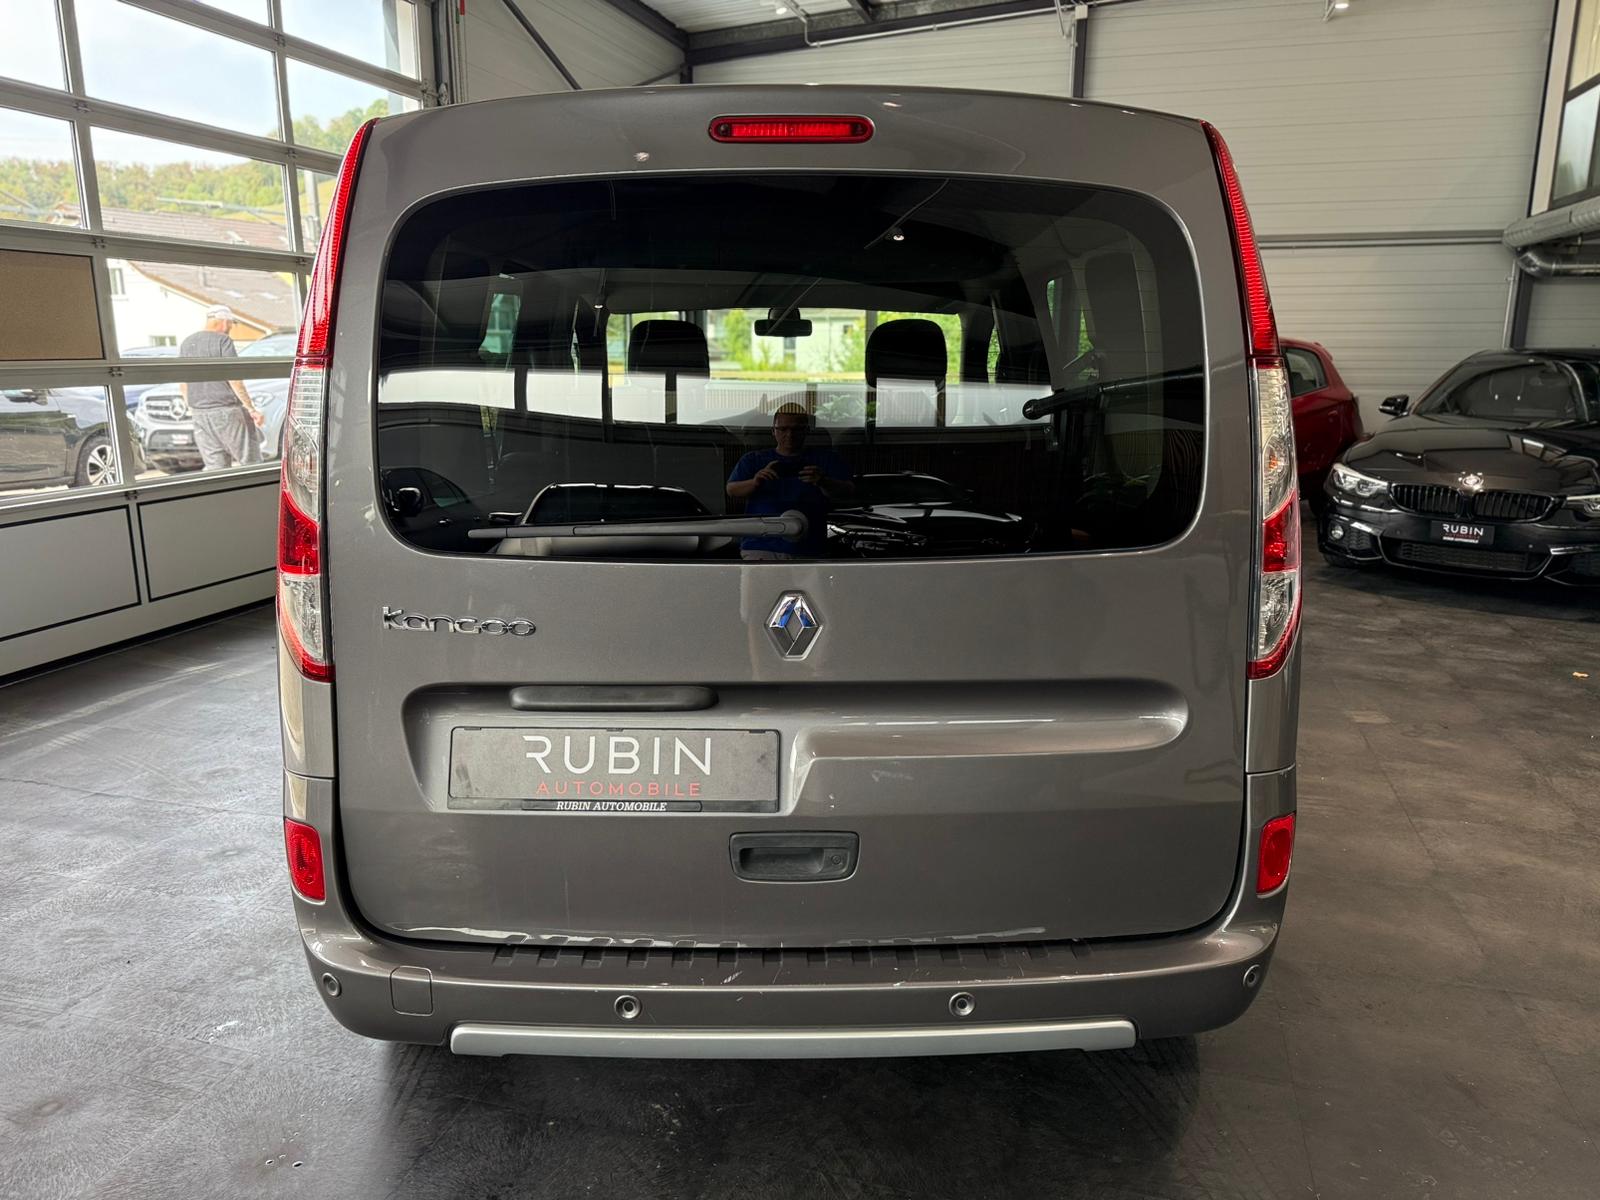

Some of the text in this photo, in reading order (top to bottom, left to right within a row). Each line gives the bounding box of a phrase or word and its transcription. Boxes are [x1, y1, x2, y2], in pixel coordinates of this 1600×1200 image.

[1442, 523, 1484, 536] RUBIN
[522, 735, 711, 776] RUBIN
[536, 781, 701, 797] AUTOMOBILE
[556, 801, 667, 812] RUBIN AUTOMOBILE
